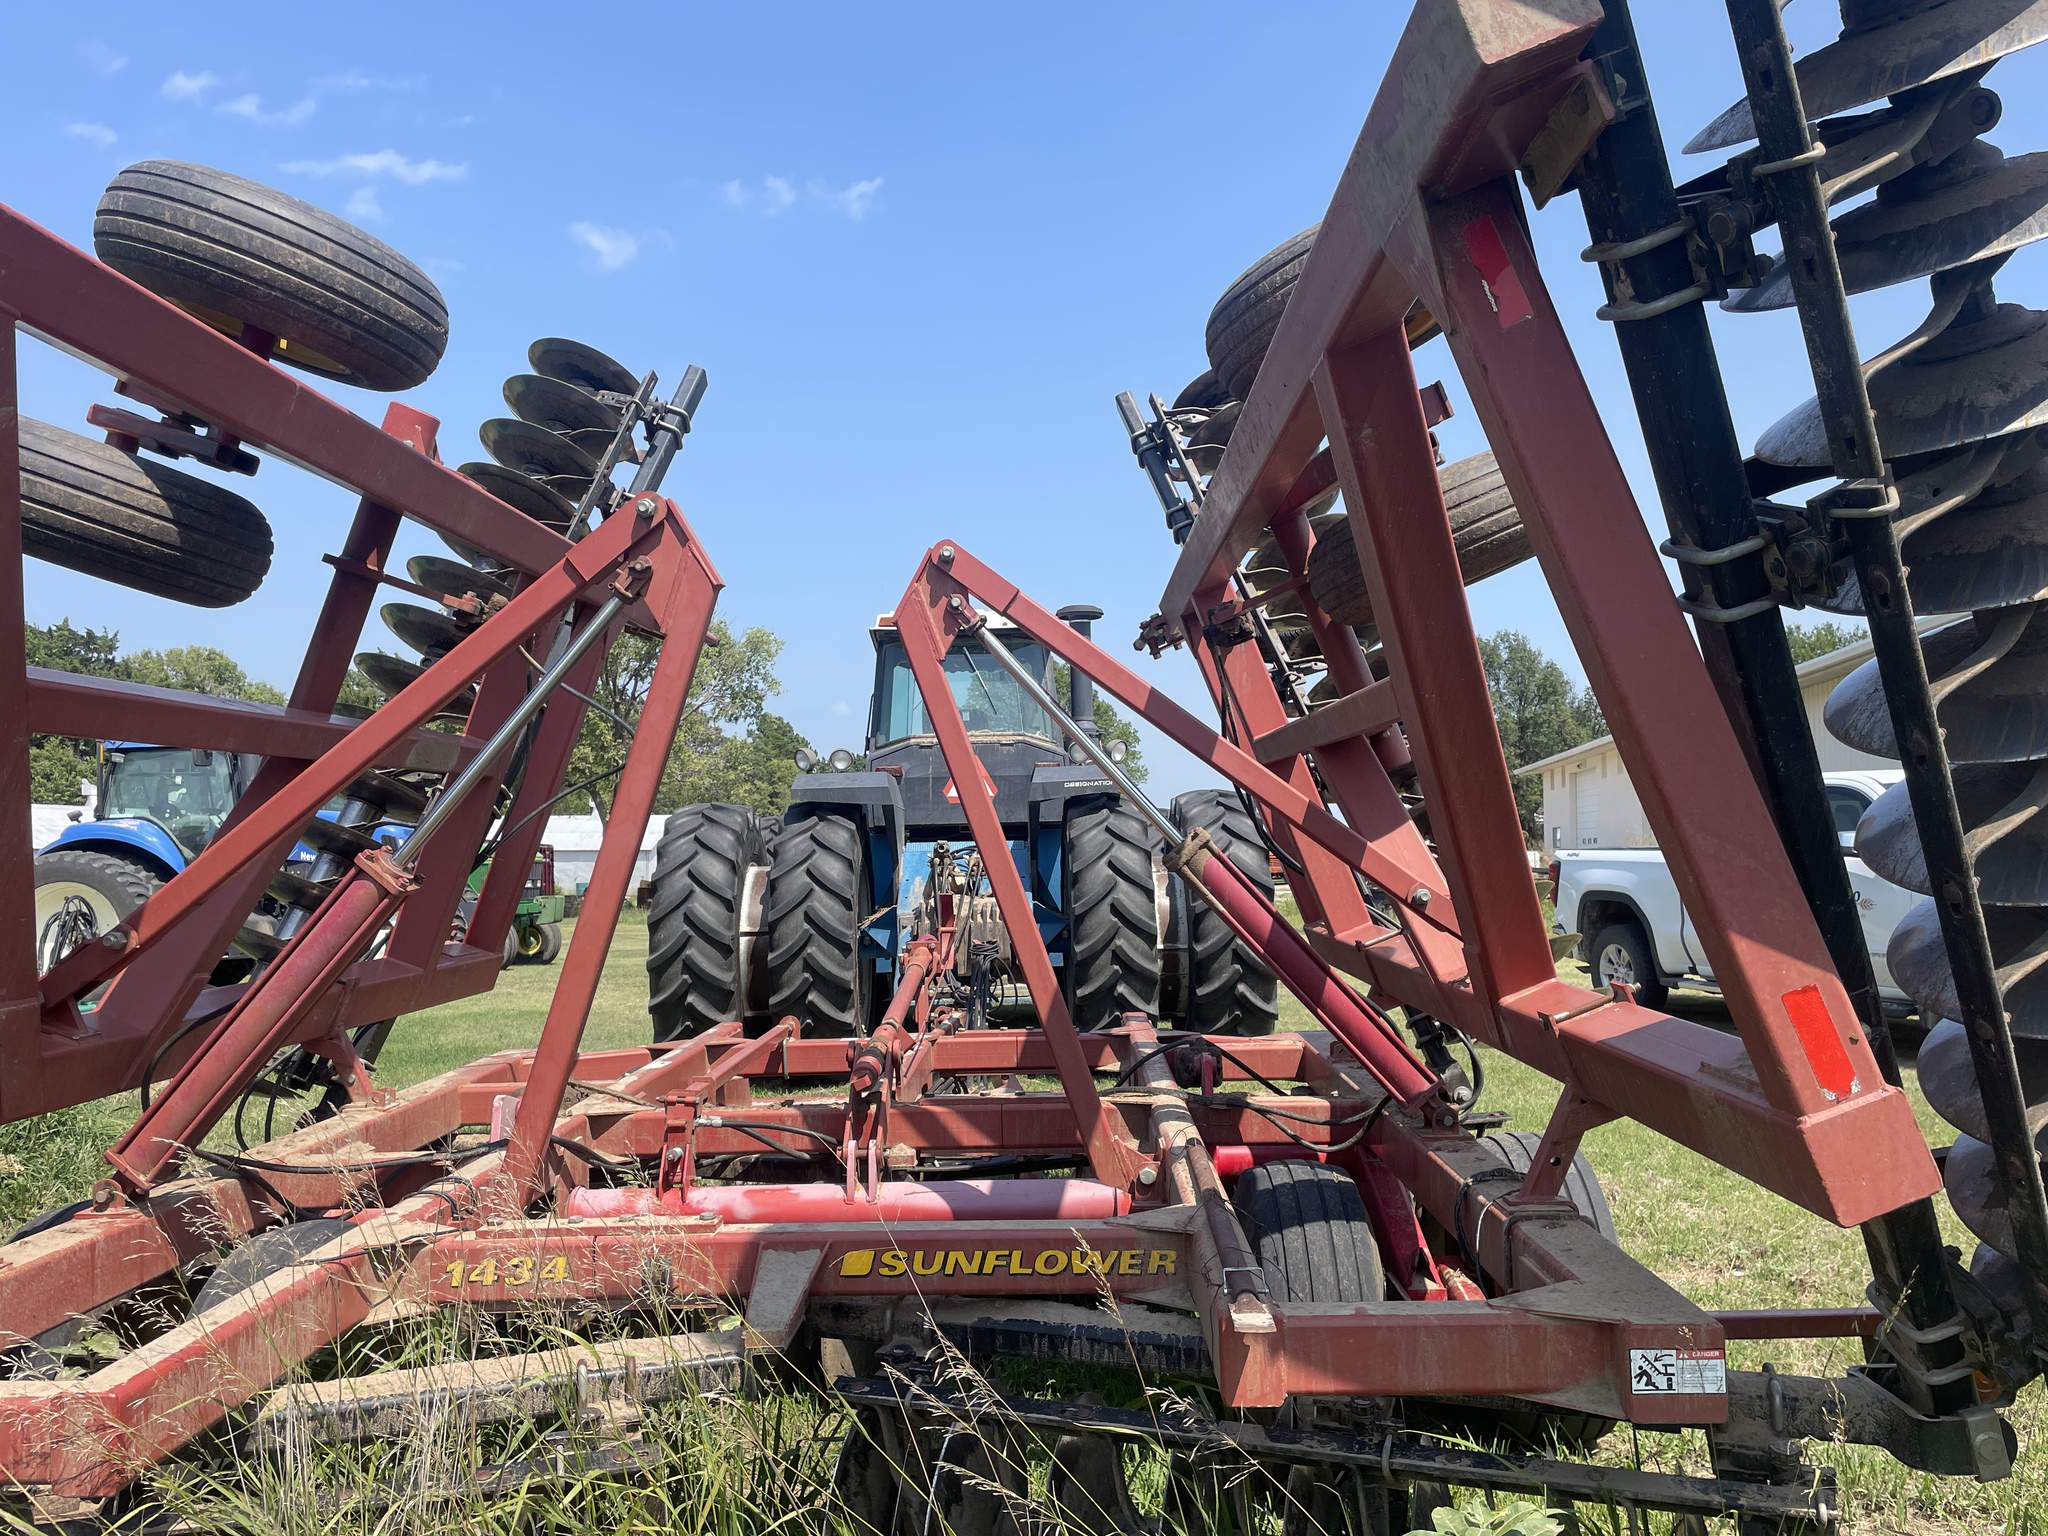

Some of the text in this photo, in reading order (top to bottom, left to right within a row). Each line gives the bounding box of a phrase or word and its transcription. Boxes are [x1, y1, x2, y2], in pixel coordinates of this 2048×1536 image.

[300, 851, 317, 861] New
[446, 1256, 569, 1287] 1434
[878, 1249, 1178, 1276] SUNFLOWER
